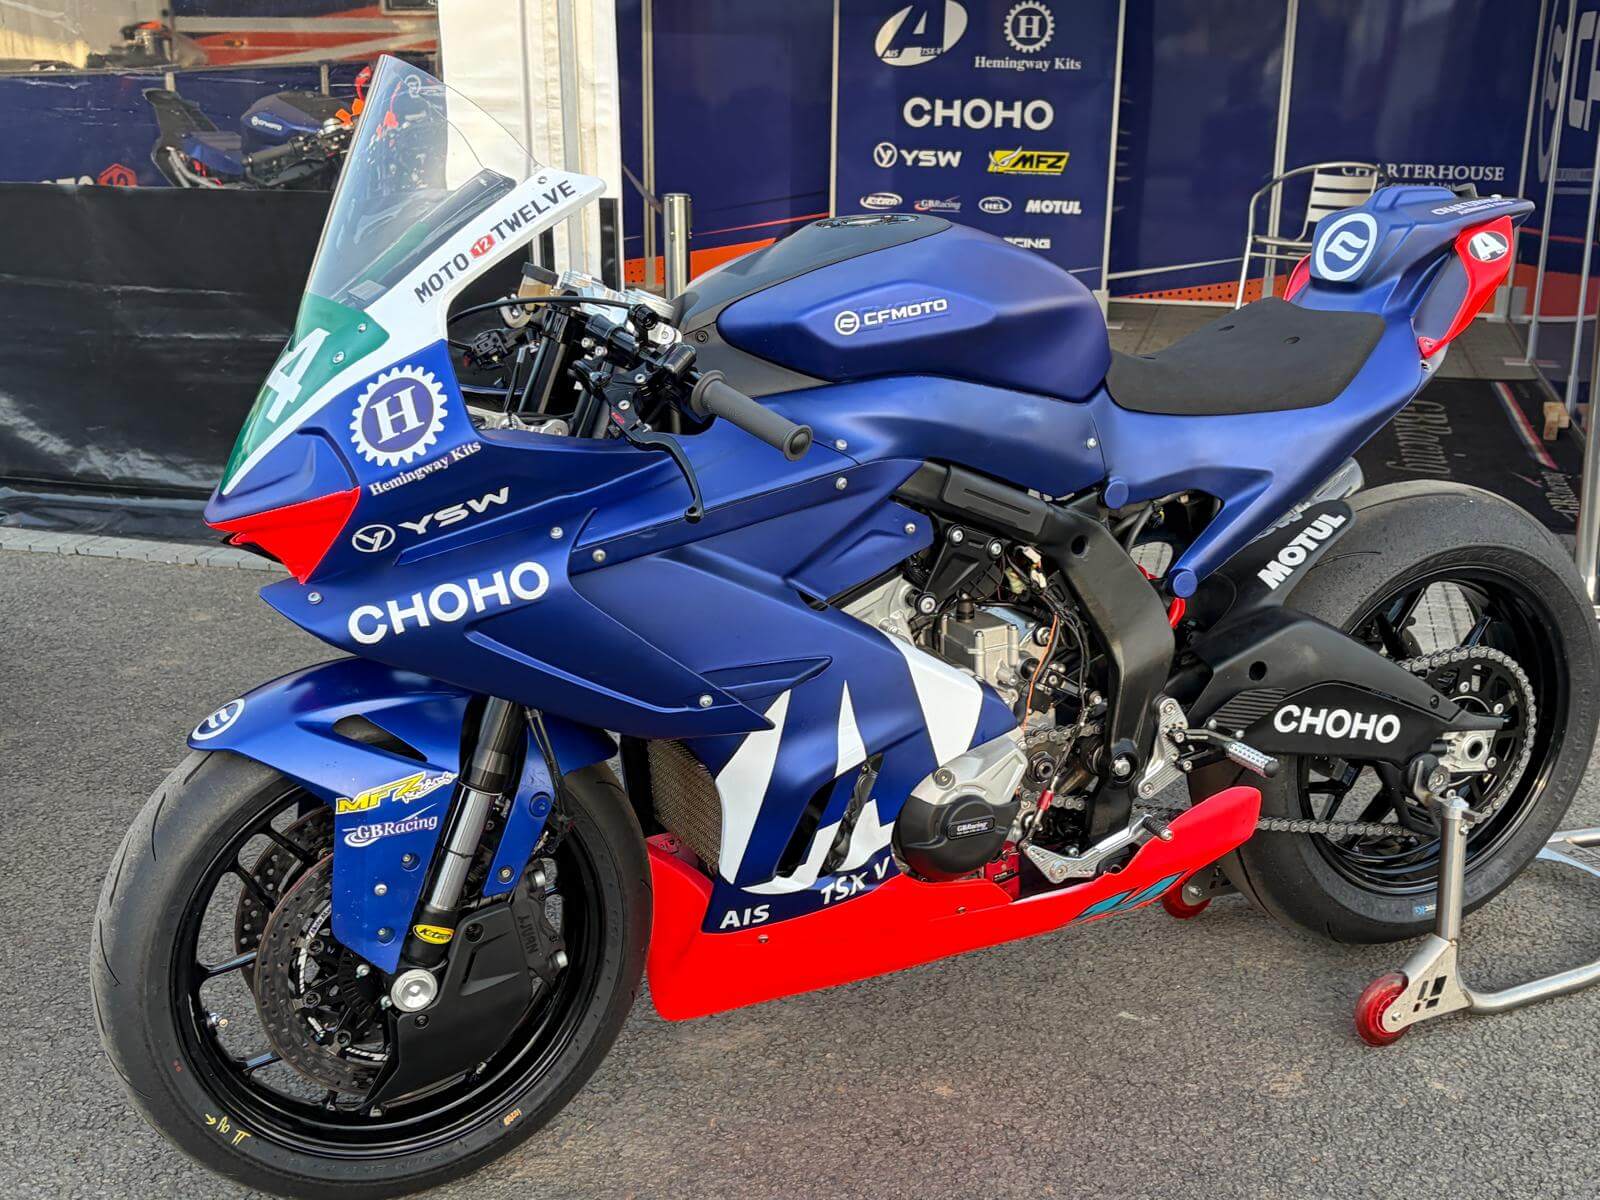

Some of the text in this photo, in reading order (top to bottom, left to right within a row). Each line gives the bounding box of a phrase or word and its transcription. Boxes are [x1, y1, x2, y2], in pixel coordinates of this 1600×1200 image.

[1016, 15, 1041, 39] H
[974, 56, 1081, 72] Hemingway Kits
[903, 97, 1054, 131] CHOHO
[901, 150, 962, 167] YSW
[1009, 153, 1066, 169] MFZ
[1024, 200, 1082, 214] MOTUL
[414, 180, 576, 304] MOTO 12 TWELVE
[863, 298, 948, 326] CFMOTO
[265, 326, 331, 423] 4
[369, 384, 426, 445] H
[368, 441, 482, 496] Hemingway Kits
[398, 486, 510, 535] YSW
[1257, 512, 1347, 590] MOTUL
[348, 561, 550, 645] CHOHO
[1273, 704, 1400, 744] CHOHO
[336, 771, 425, 814] MFZ
[356, 815, 439, 843] GBRacing
[720, 856, 891, 930] AIS TSX V
